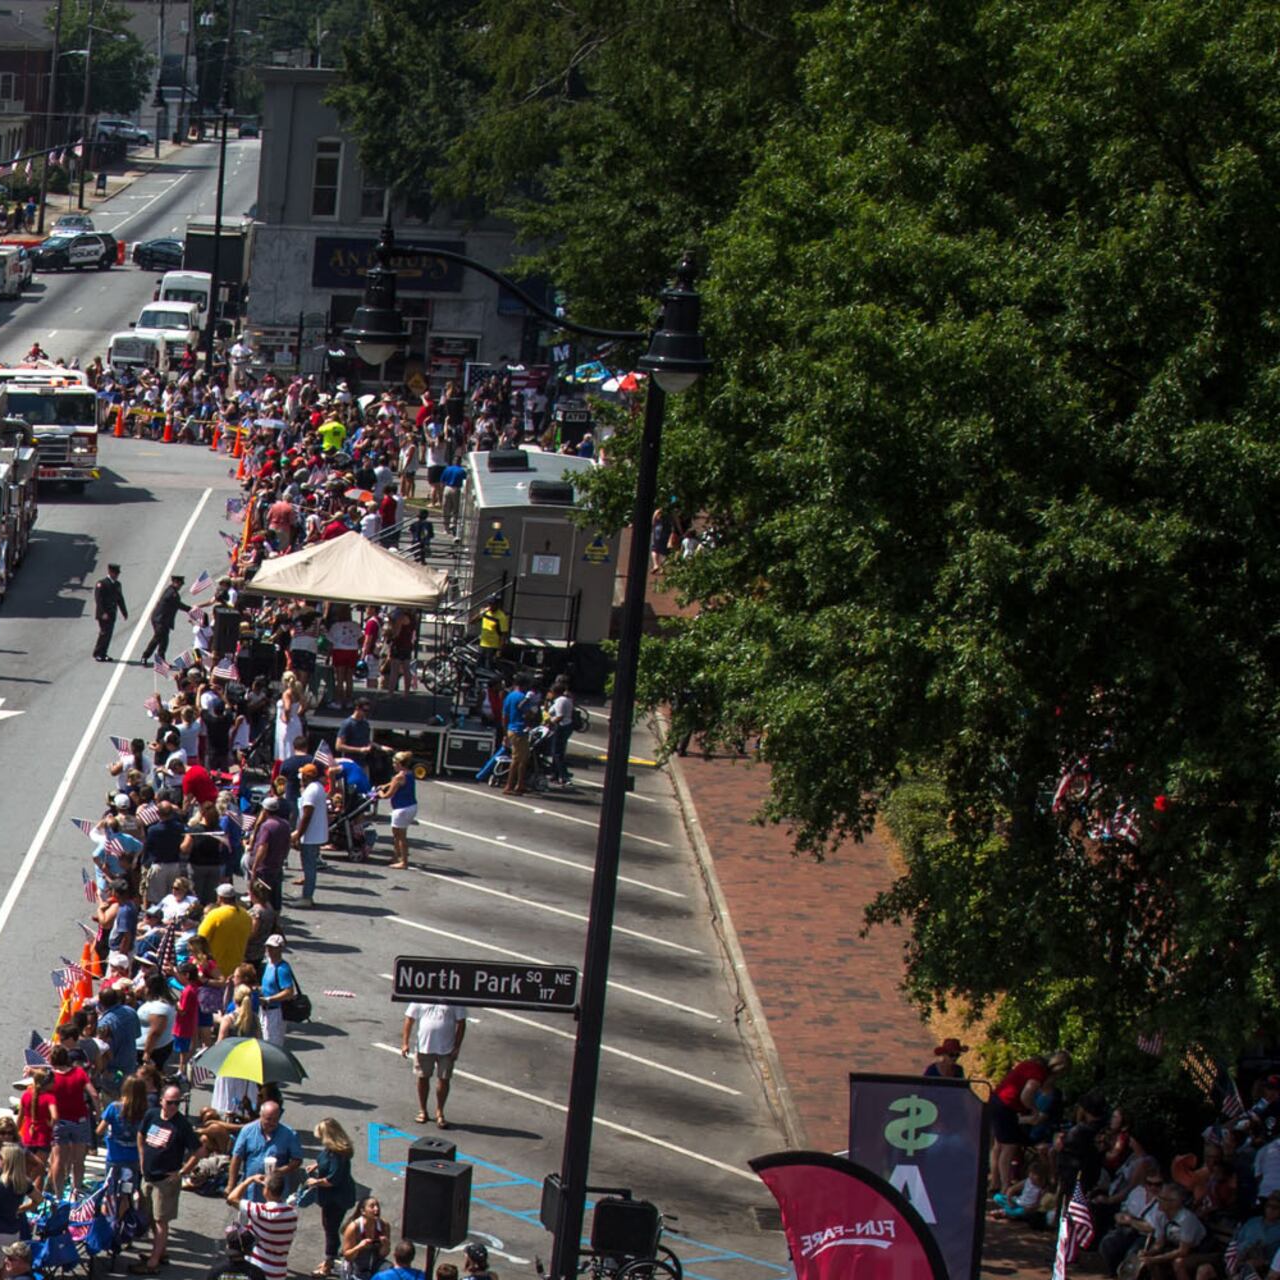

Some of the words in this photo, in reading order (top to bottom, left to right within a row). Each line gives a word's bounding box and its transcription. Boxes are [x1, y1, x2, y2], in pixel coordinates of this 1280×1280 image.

[71, 249, 100, 259] POLICE
[566, 412, 587, 422] ATM
[399, 966, 460, 991] North
[474, 971, 522, 995] Park
[555, 973, 572, 986] NE
[539, 988, 555, 1001] 117
